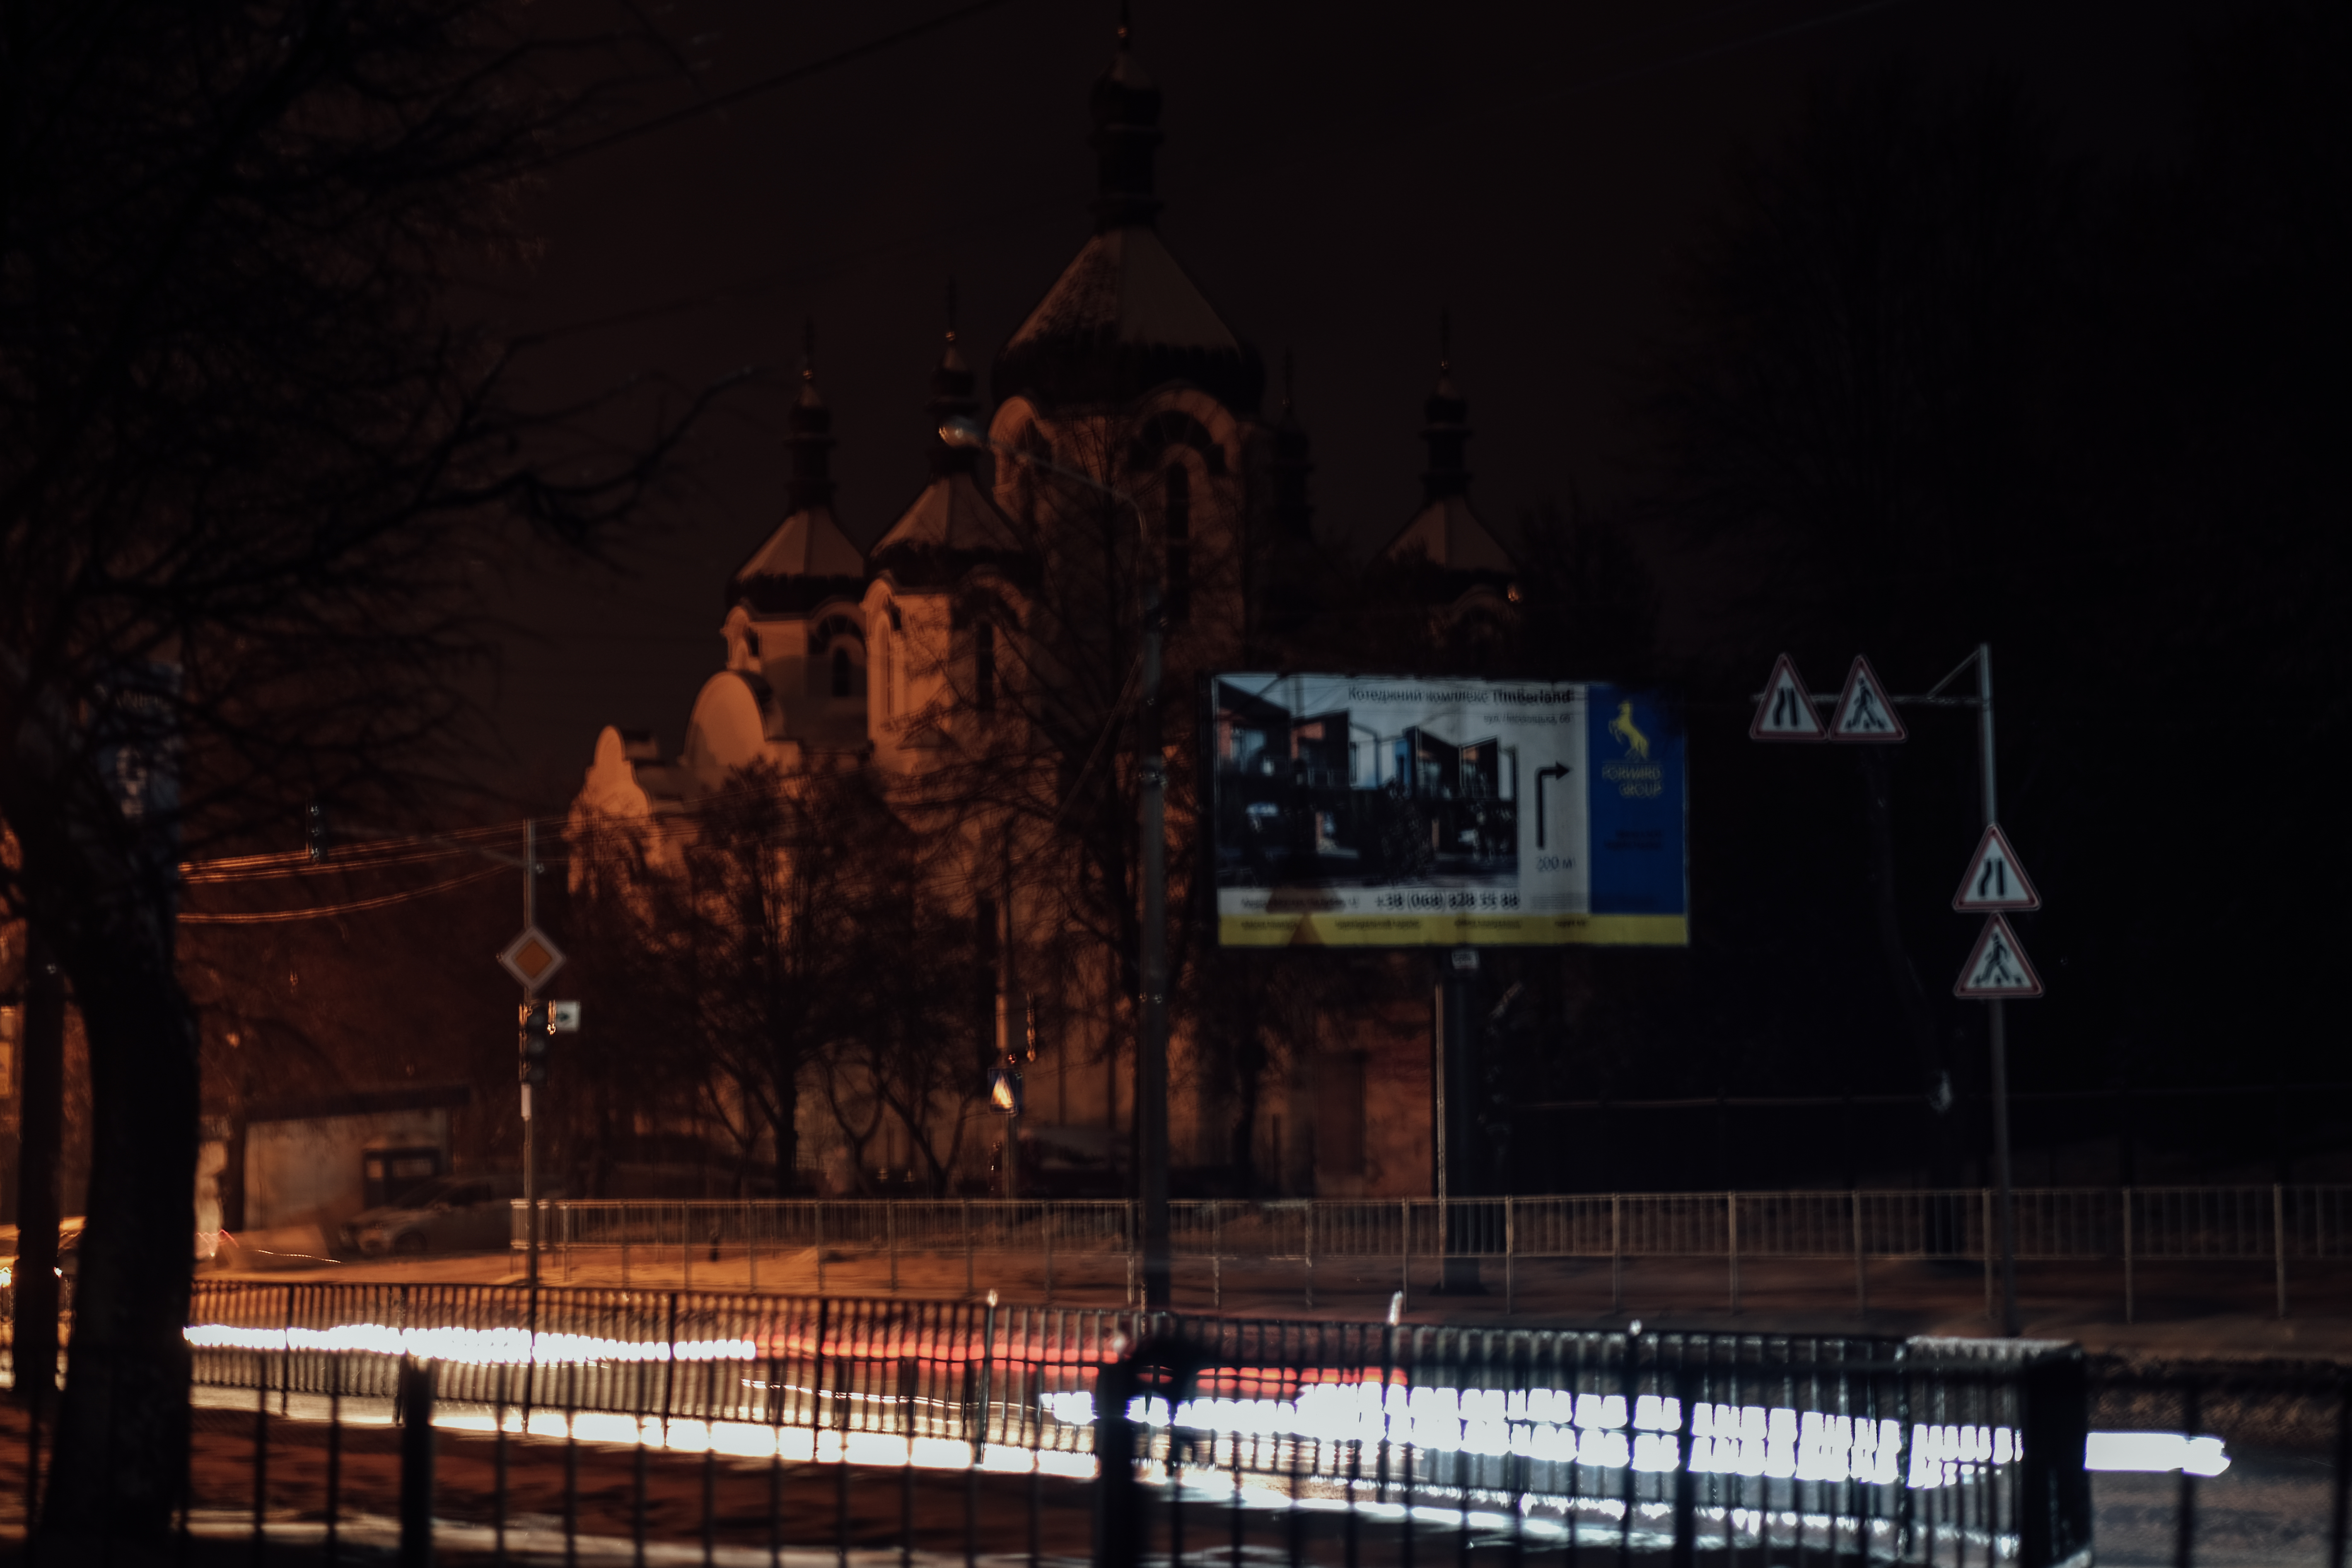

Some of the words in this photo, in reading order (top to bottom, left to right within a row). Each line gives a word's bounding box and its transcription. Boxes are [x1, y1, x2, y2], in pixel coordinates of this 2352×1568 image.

[1348, 687, 1422, 703] Котеджний
[1426, 689, 1488, 703] комплекс
[1493, 688, 1571, 703] Timberland
[1602, 766, 1662, 780] FORWARD
[1619, 783, 1663, 798] GROUP
